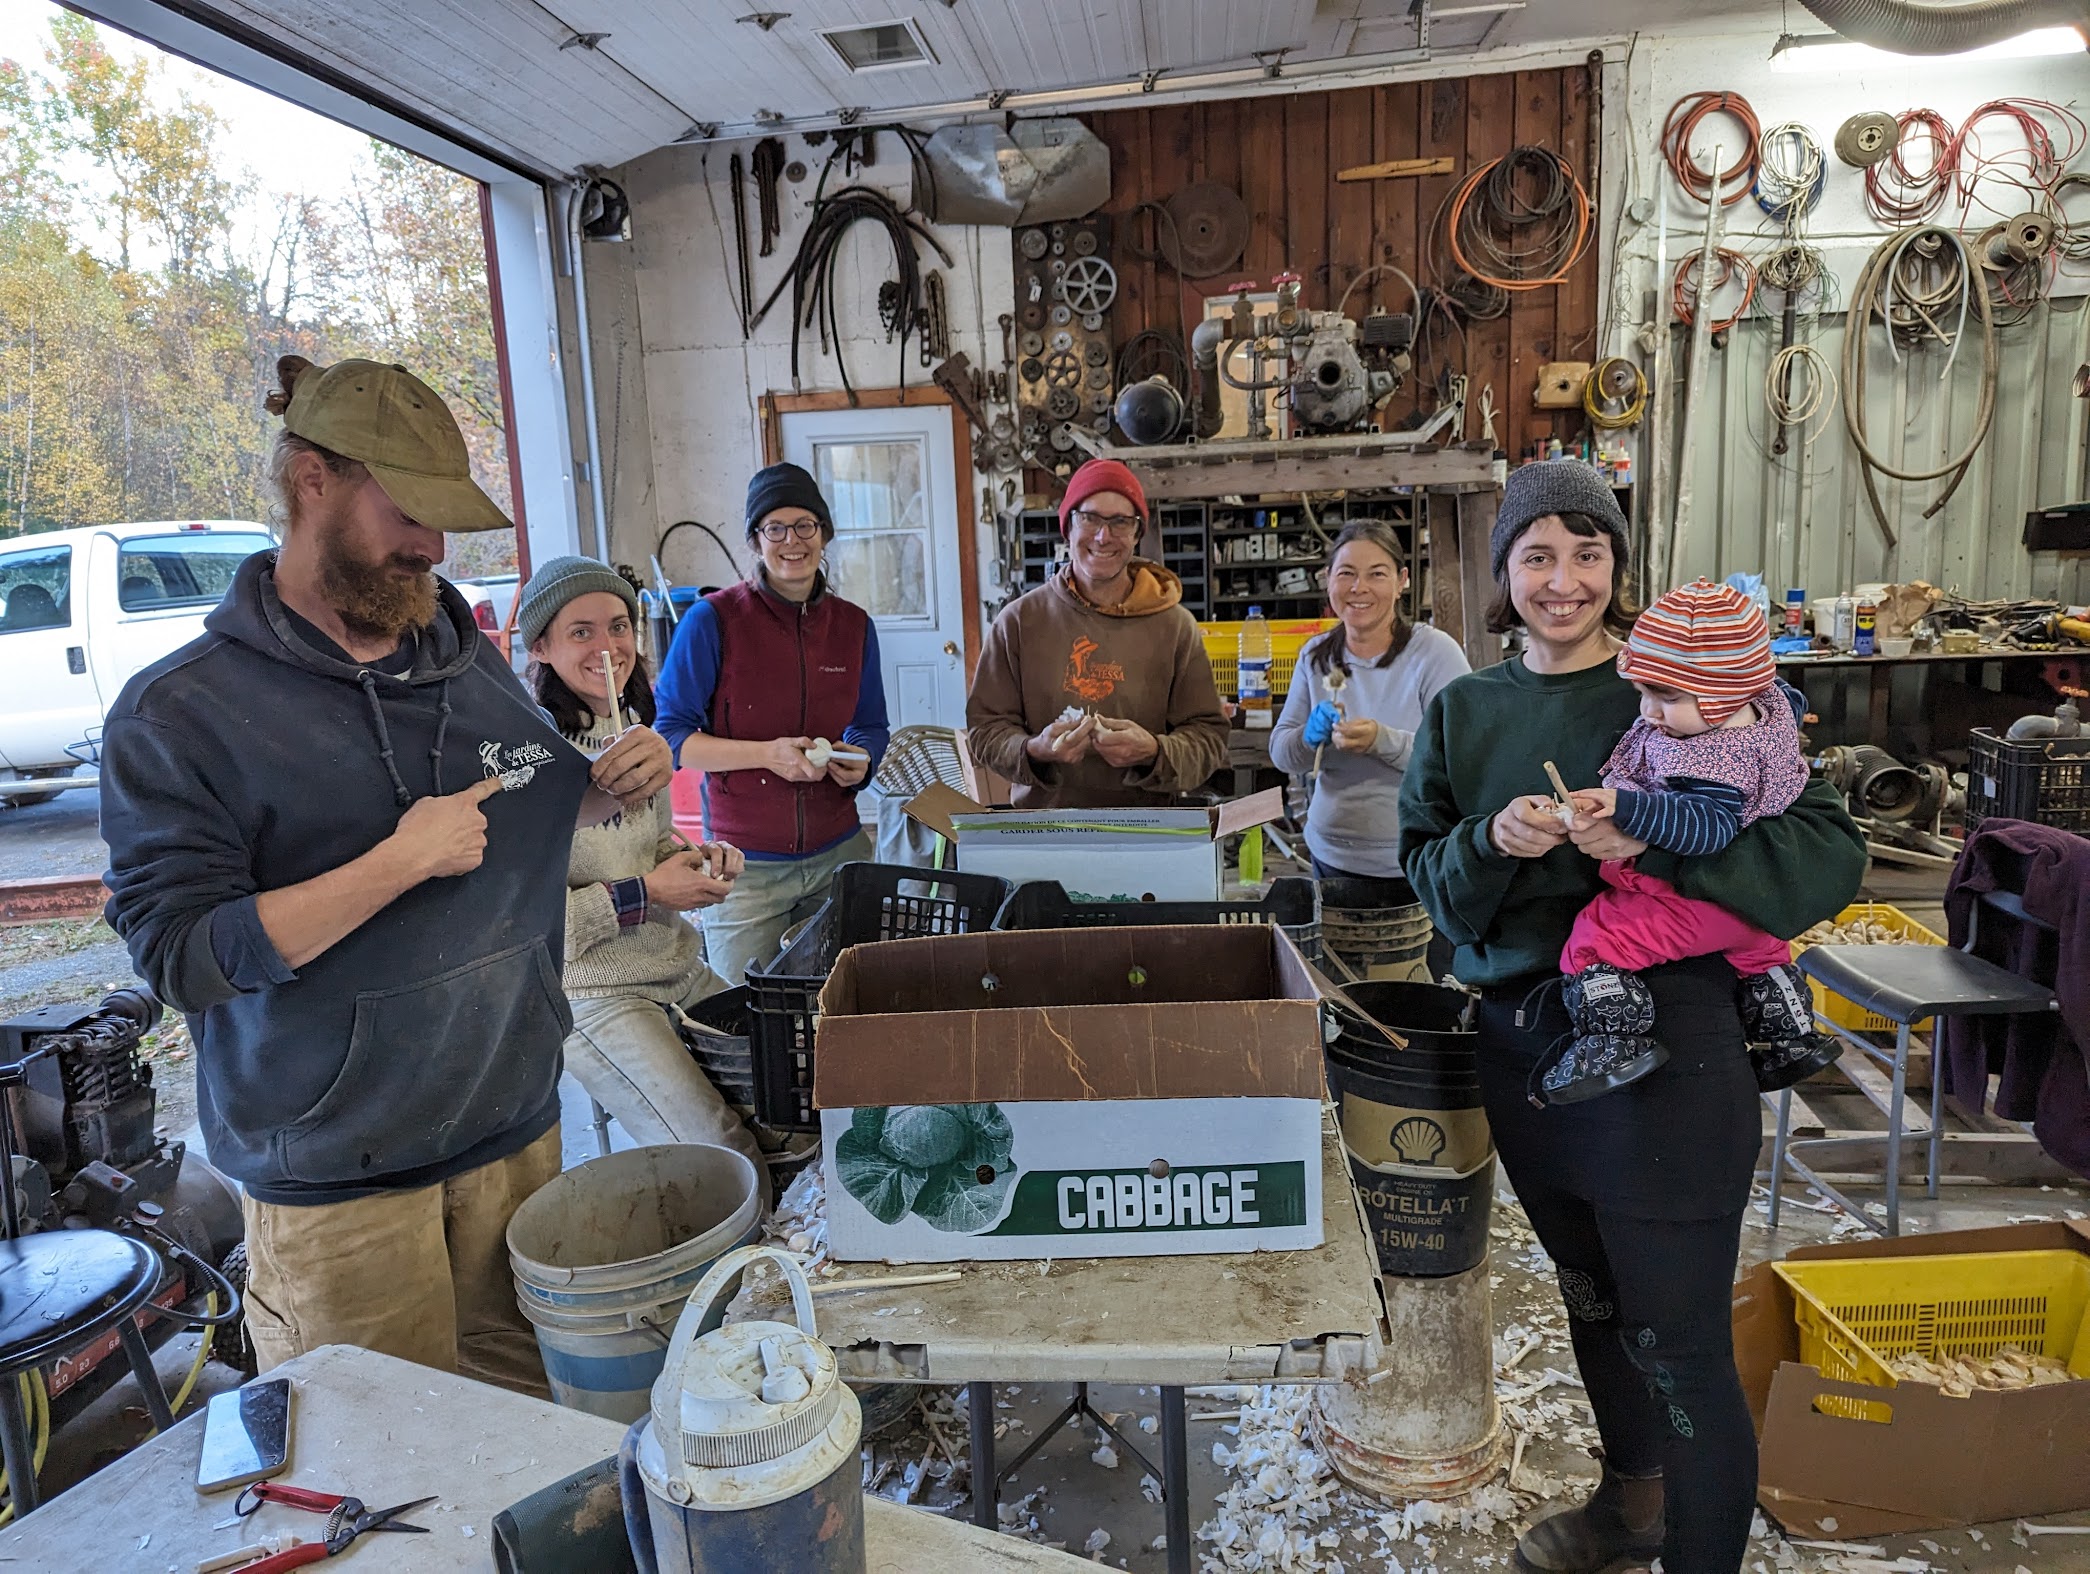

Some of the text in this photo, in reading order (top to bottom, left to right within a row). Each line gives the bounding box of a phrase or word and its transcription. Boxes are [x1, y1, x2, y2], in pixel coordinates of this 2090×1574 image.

[515, 747, 553, 765] TESSA
[1057, 1170, 1260, 1229] CABBAGE
[1383, 1211, 1443, 1225] MULTIGRADE
[1380, 1228, 1445, 1250] 15W-40
